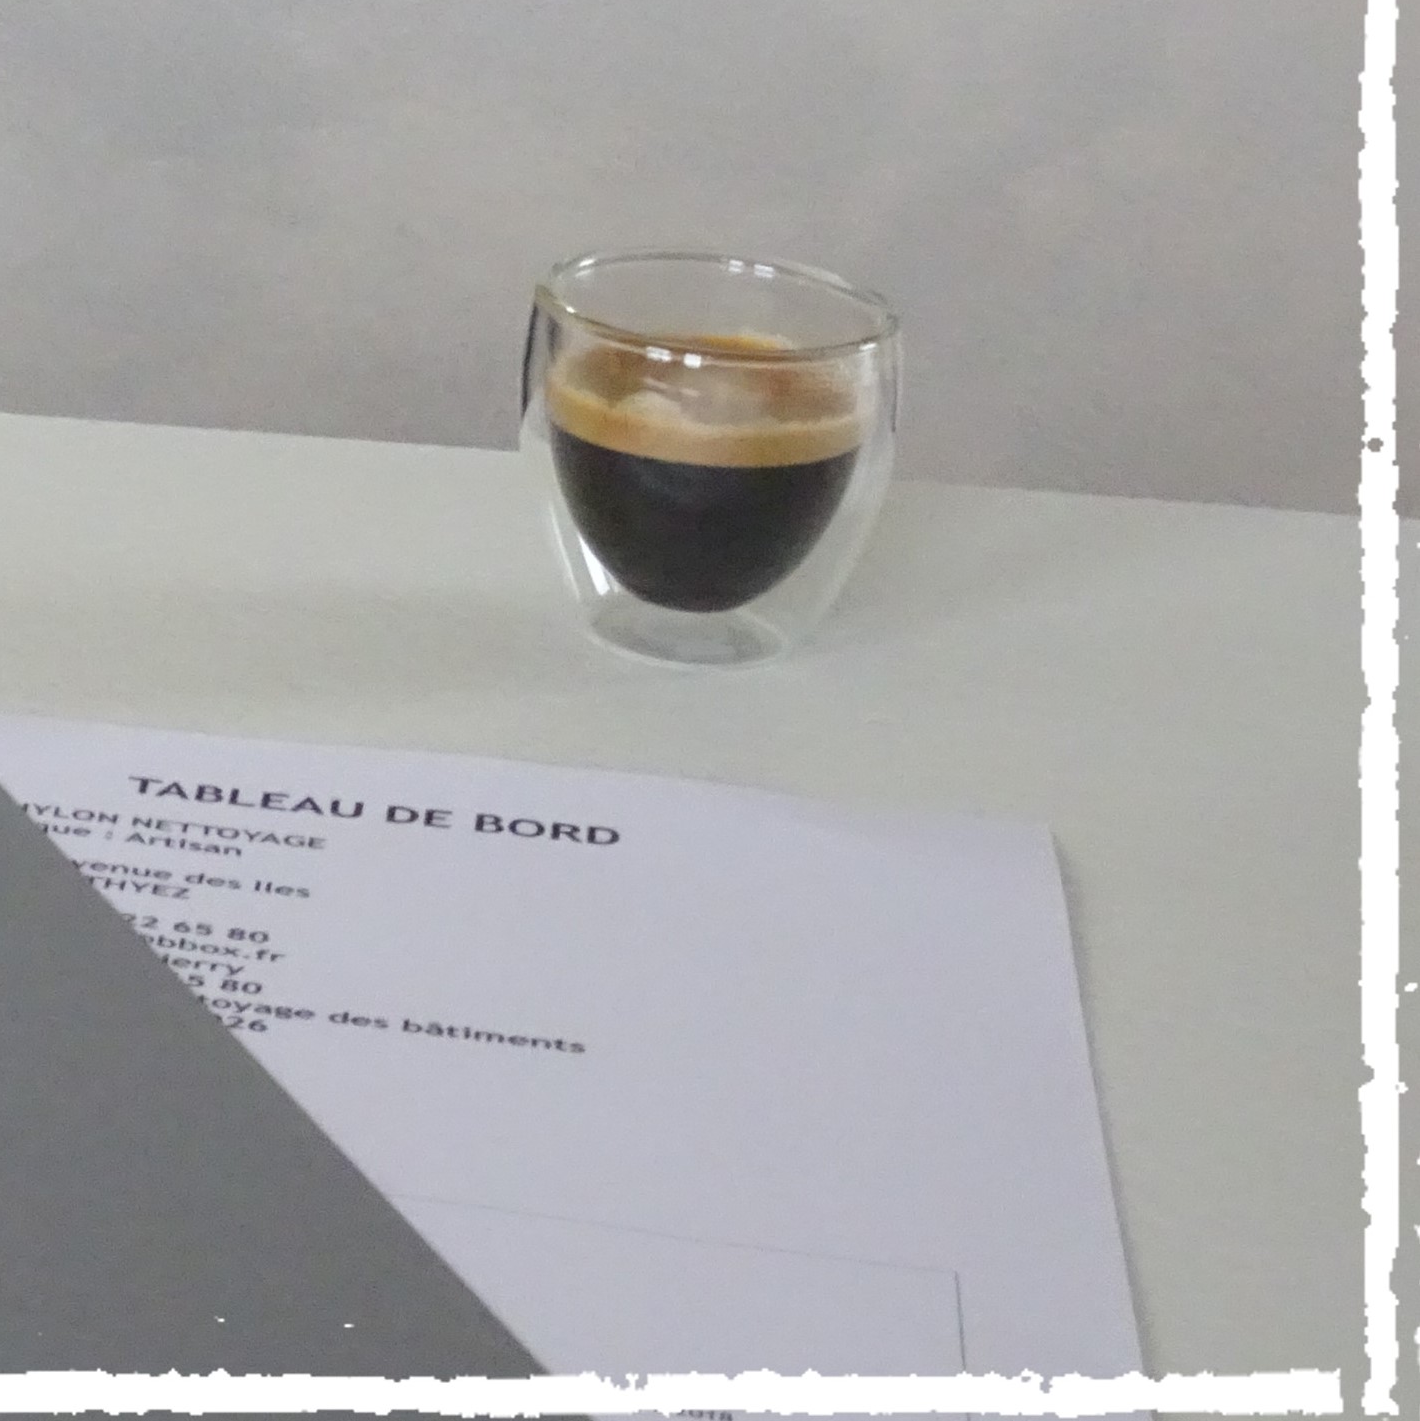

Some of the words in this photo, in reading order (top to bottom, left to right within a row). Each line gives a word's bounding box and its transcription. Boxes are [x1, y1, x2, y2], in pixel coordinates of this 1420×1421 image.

[128, 776, 364, 819] TABLEAU
[386, 806, 453, 829] DE
[476, 815, 621, 846] BORD
[125, 832, 242, 857] Artisan
[132, 816, 327, 850] NETTOYAGE
[185, 873, 242, 889] des
[173, 922, 213, 936] 65
[227, 928, 270, 944] 80
[220, 979, 262, 995] 80
[328, 1011, 389, 1029] des
[402, 1018, 586, 1055] bâtiments
